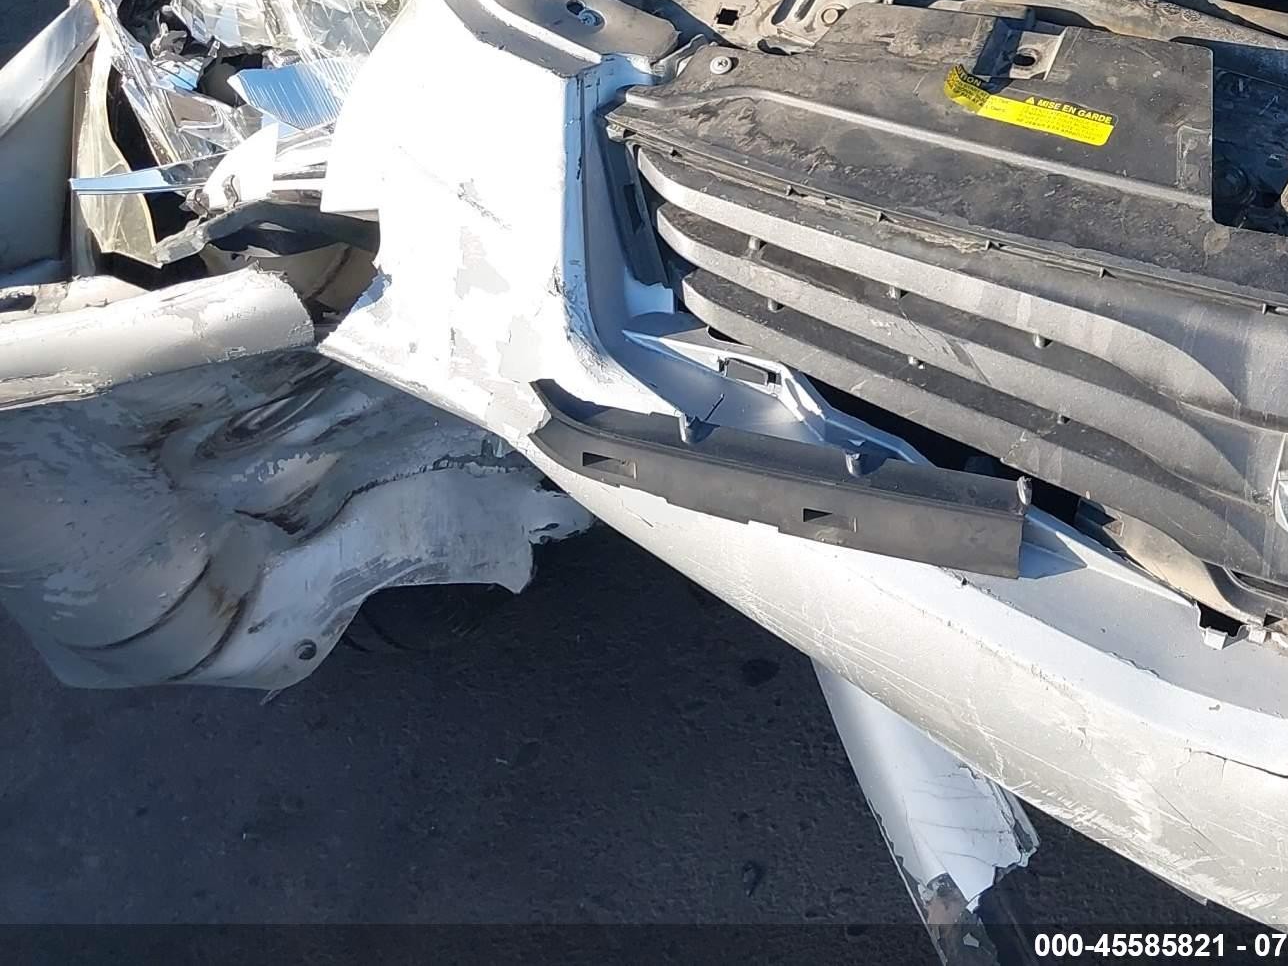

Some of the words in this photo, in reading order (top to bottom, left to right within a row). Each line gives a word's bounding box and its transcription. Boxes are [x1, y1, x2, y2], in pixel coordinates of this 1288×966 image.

[1037, 99, 1061, 111] MISE
[1063, 104, 1077, 114] EN
[1077, 109, 1113, 124] GARDE
